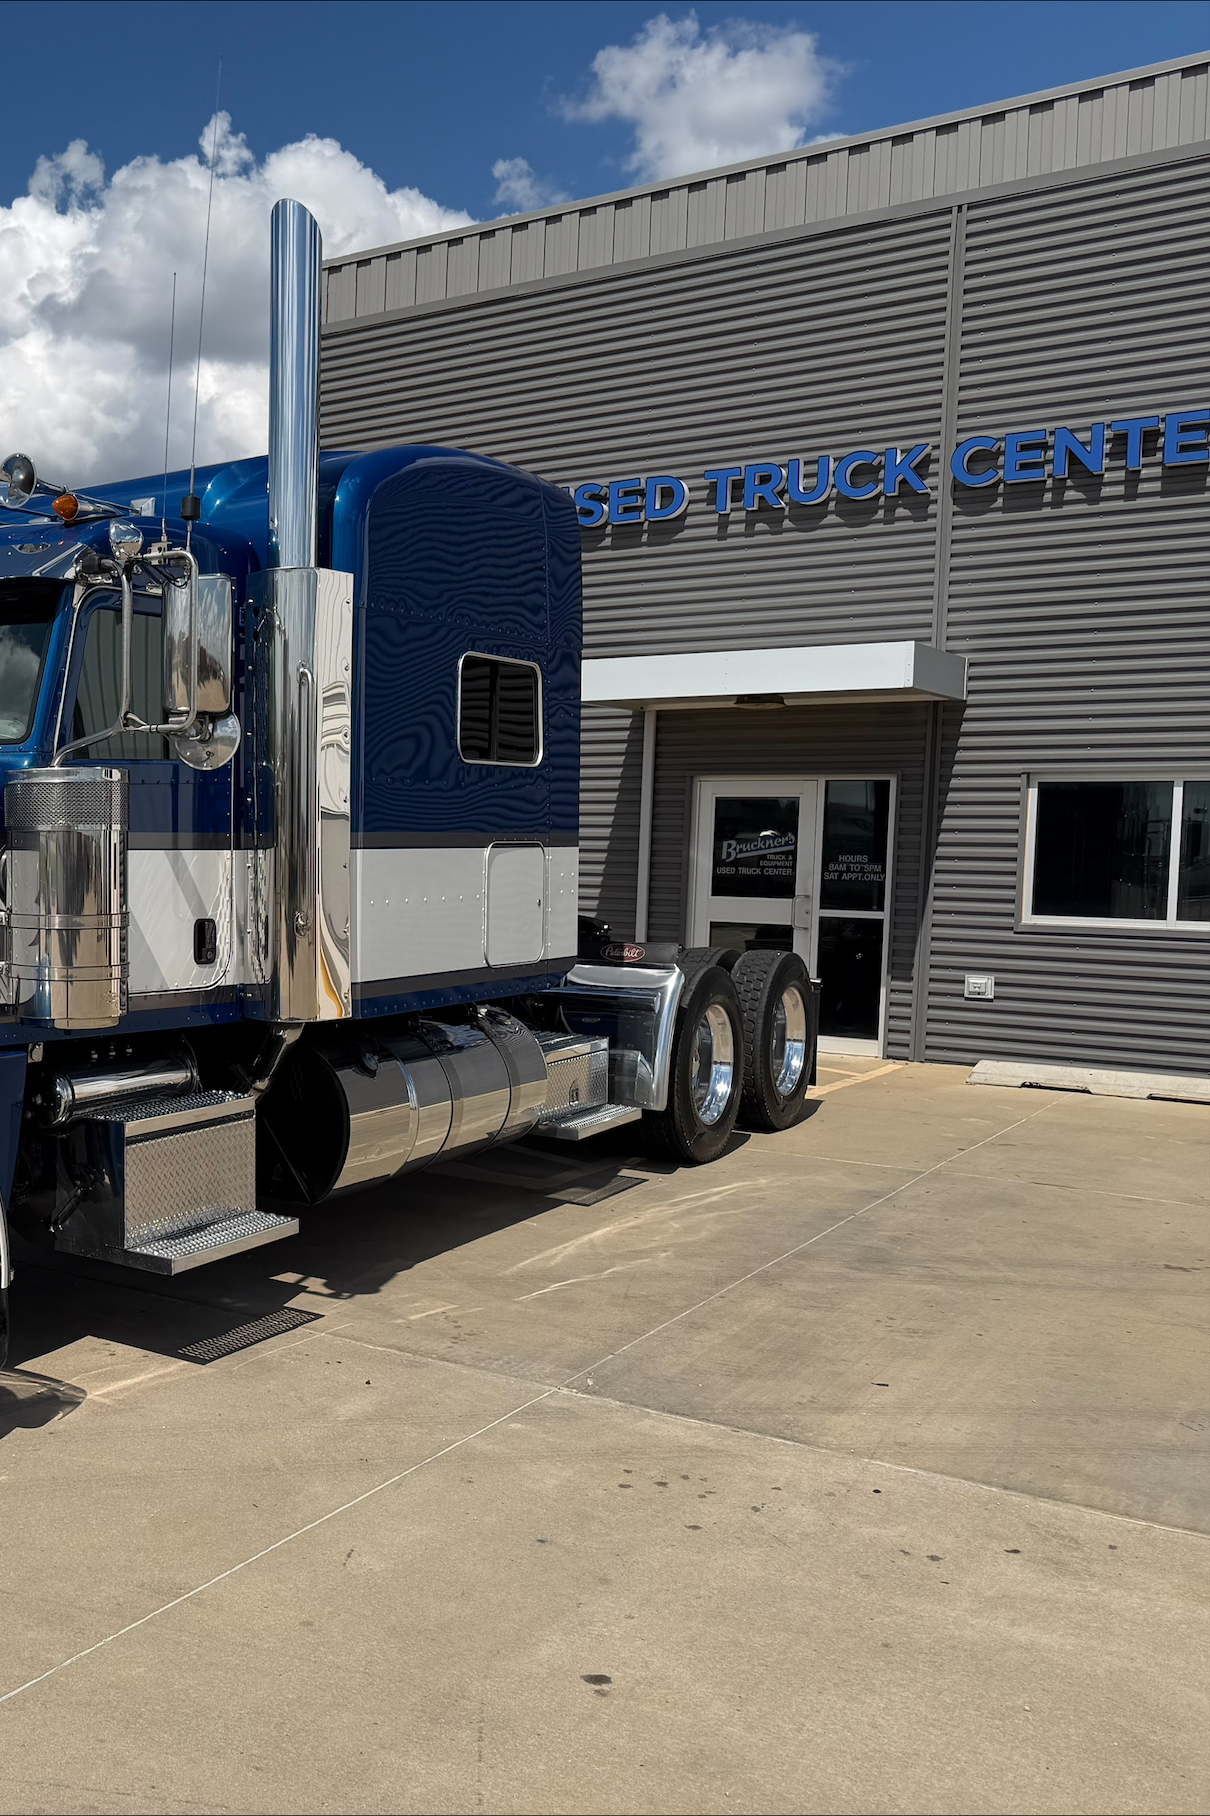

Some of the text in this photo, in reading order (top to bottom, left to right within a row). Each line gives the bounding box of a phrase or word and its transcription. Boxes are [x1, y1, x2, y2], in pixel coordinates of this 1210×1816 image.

[561, 408, 1210, 527] SED TRUCK CENTE
[838, 854, 869, 863] HOURS
[716, 866, 793, 876] USED TRUCK CENTER
[828, 863, 882, 873] 8AM TO 5PM
[823, 871, 839, 880] SAT
[605, 946, 642, 958] Peterbilt
